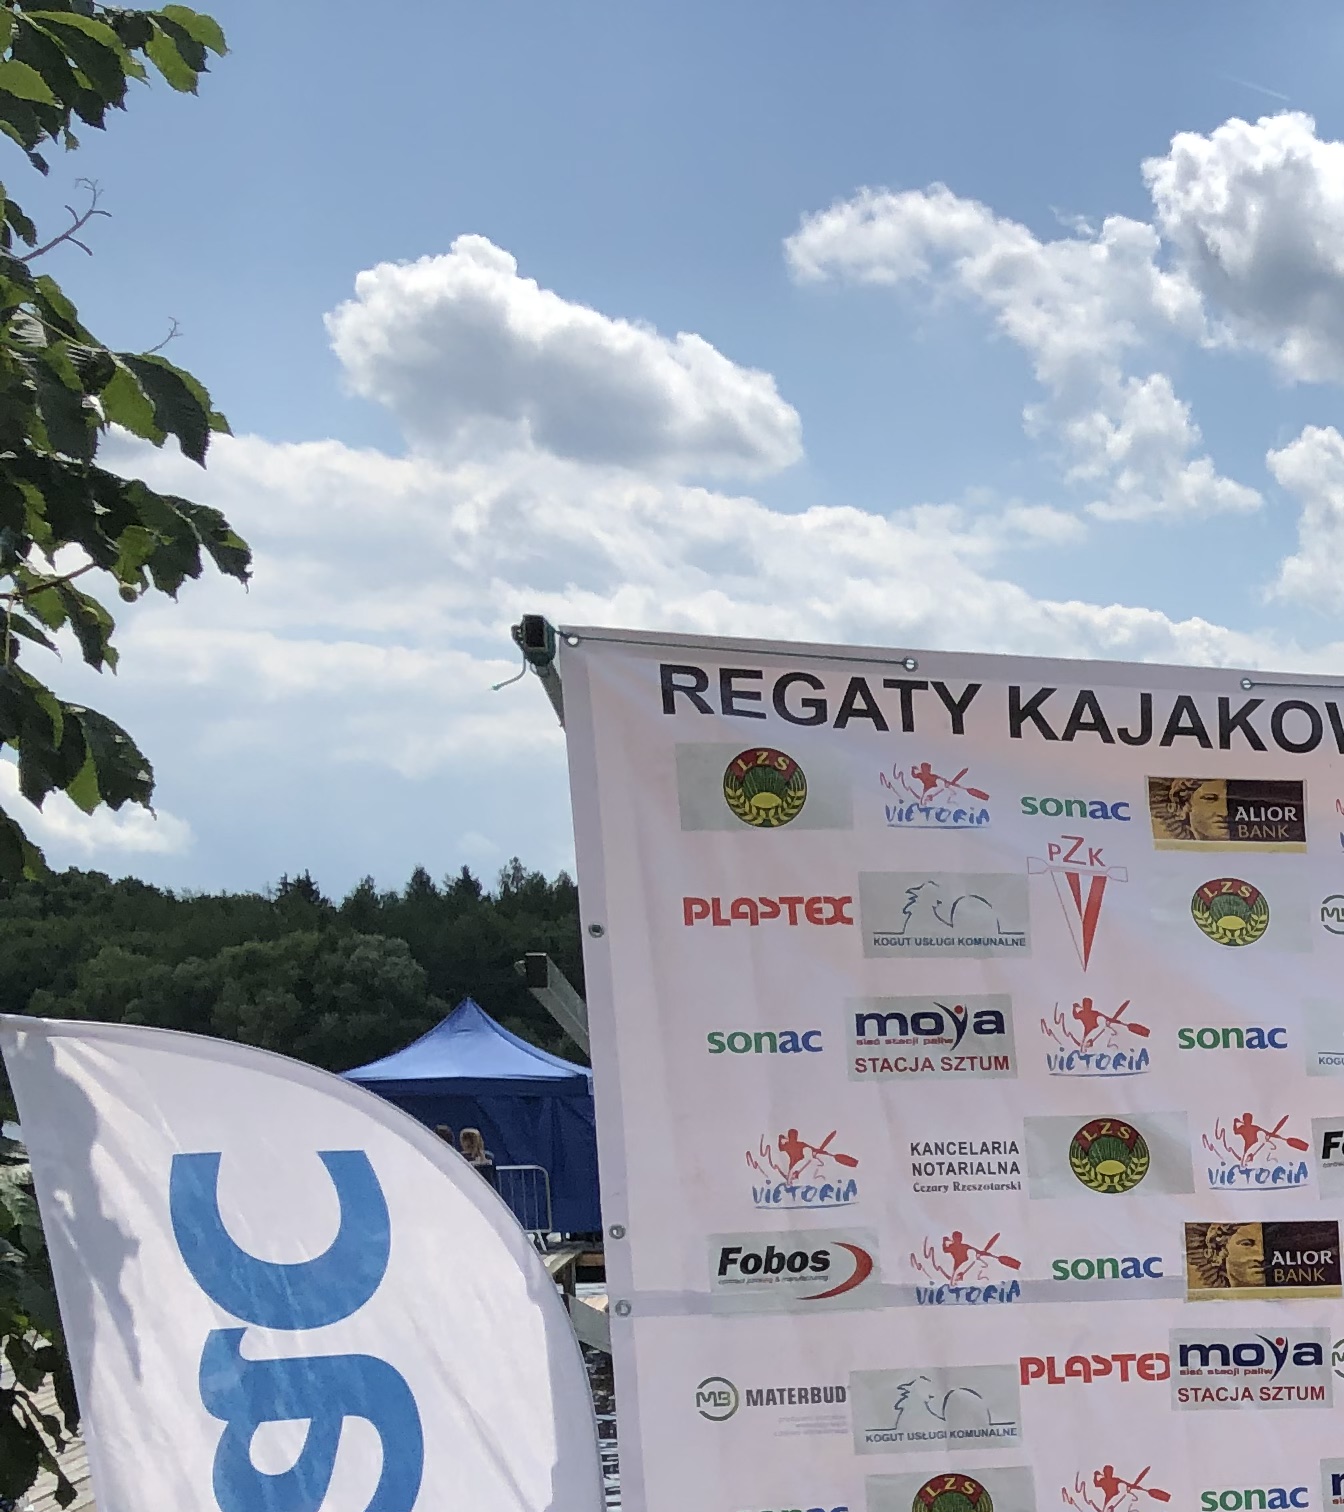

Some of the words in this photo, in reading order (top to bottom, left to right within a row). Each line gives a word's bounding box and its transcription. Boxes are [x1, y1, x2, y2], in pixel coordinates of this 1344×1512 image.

[659, 663, 982, 735] REGATY
[734, 750, 791, 772] LZS
[1021, 796, 1131, 822] sonac
[1234, 806, 1298, 823] ALIOR
[1238, 824, 1288, 839] BANK
[1048, 836, 1106, 867] PZK
[1205, 880, 1253, 899] LZS
[683, 896, 853, 927] PLASTEX
[874, 937, 911, 947] KOGUT
[914, 936, 955, 947] USŁUGI
[957, 937, 1026, 947] KOMUNALNE
[855, 1002, 1005, 1050] moya
[707, 1030, 823, 1053] sonac
[1177, 1027, 1288, 1050] sonac
[855, 1057, 935, 1073] STACJA
[941, 1056, 1010, 1072] SZTUM
[1083, 1121, 1133, 1143] LZS
[910, 1141, 1020, 1156] KANCELARIA
[911, 1161, 1021, 1177] NOTARIALNA
[913, 1181, 949, 1193] Cezary
[718, 1246, 830, 1276] Fobos
[1052, 1256, 1163, 1280] sonac
[1271, 1250, 1334, 1266] ALIOR
[1274, 1267, 1327, 1283] BANK
[1179, 1333, 1323, 1381] moya
[745, 1386, 847, 1407] MATERBUD
[1177, 1387, 1255, 1403] STACJA
[1259, 1386, 1325, 1401] SZTUM
[865, 1432, 904, 1443] KOGUT
[906, 1430, 948, 1442] USŁUGI
[950, 1427, 1018, 1439] KOMUNALNE
[926, 1477, 976, 1499] LZS
[1201, 1486, 1308, 1512] sonac
